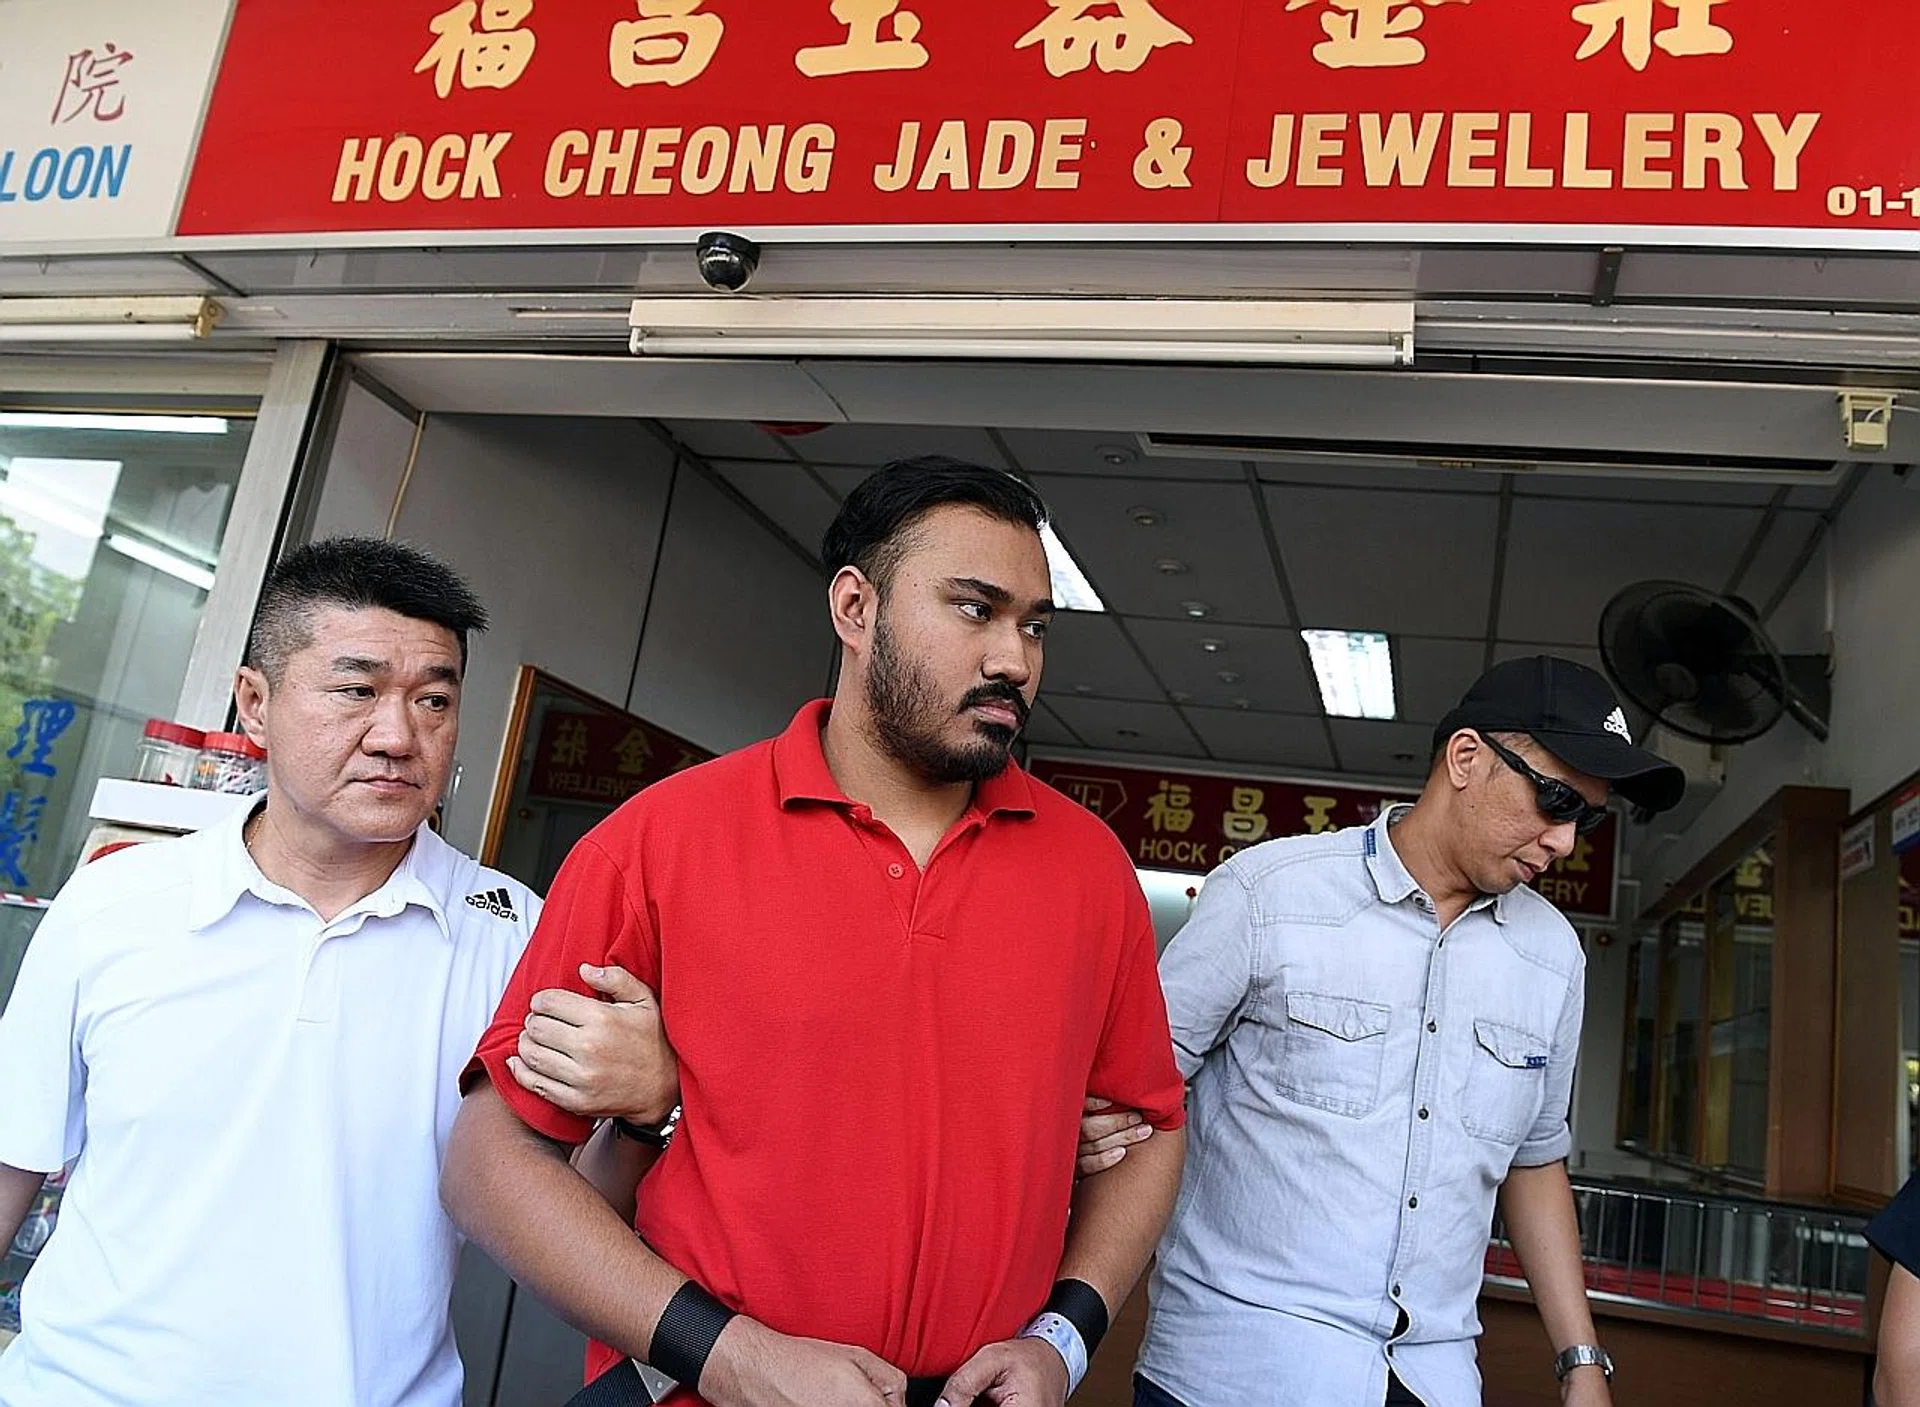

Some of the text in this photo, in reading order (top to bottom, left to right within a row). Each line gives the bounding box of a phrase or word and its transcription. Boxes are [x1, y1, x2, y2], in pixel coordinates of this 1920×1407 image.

[51, 43, 134, 124] 院
[331, 112, 1821, 202] HOCK CHEONG JADE & JEWELLERY
[1139, 837, 1208, 865] HOCK
[464, 895, 519, 923] adidas
